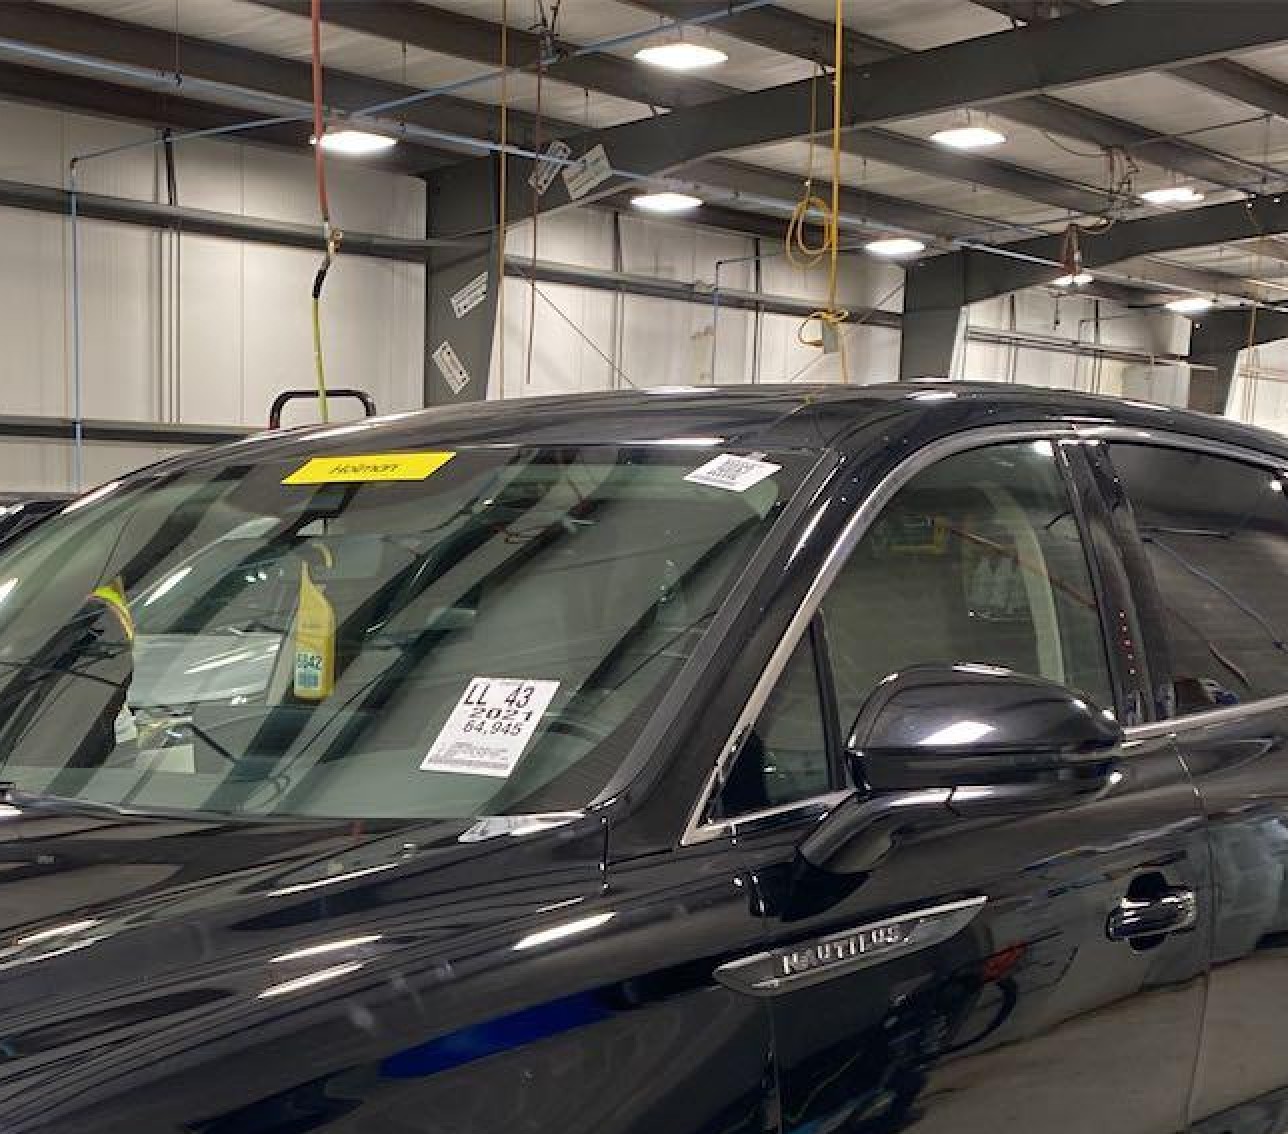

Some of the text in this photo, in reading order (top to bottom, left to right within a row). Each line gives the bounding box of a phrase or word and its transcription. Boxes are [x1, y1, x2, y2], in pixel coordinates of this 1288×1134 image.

[463, 682, 535, 708] LL 43
[469, 707, 533, 722] 2021
